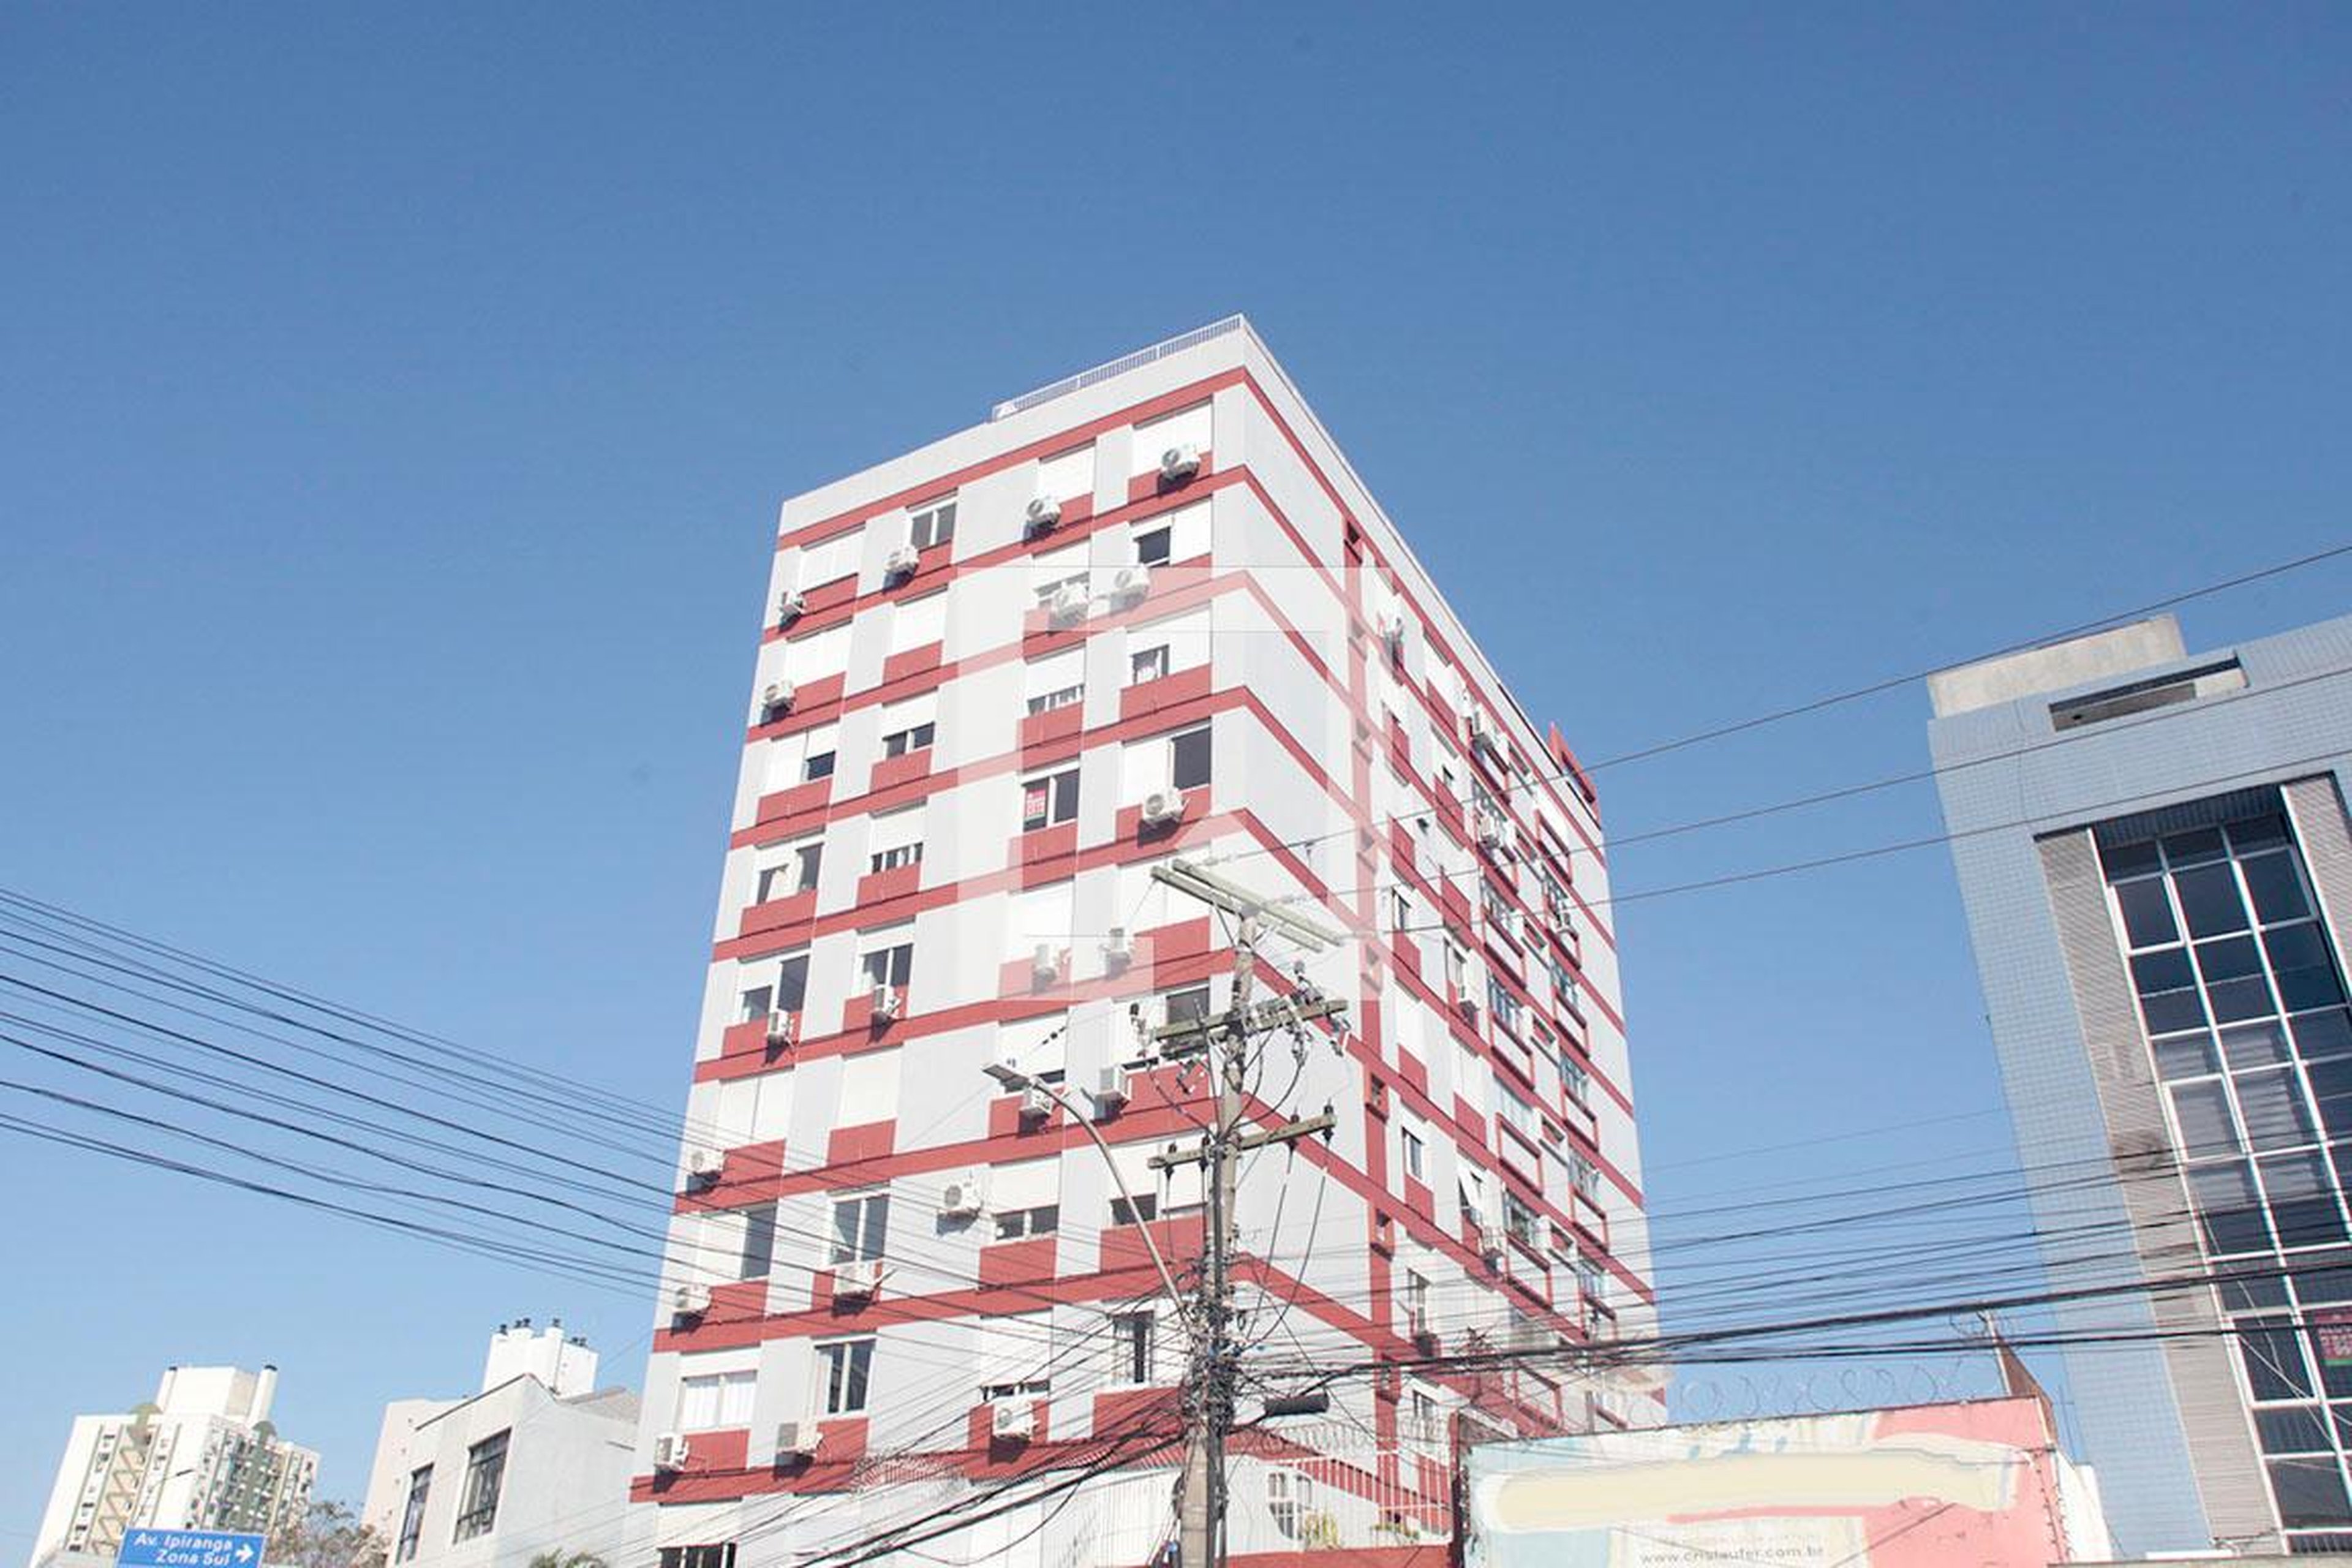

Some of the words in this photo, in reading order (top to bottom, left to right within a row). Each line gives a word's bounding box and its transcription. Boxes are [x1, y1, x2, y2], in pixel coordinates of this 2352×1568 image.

[164, 1534, 233, 1551] Ipiranga
[156, 1549, 198, 1564] Zona
[203, 1551, 231, 1566] Sul
